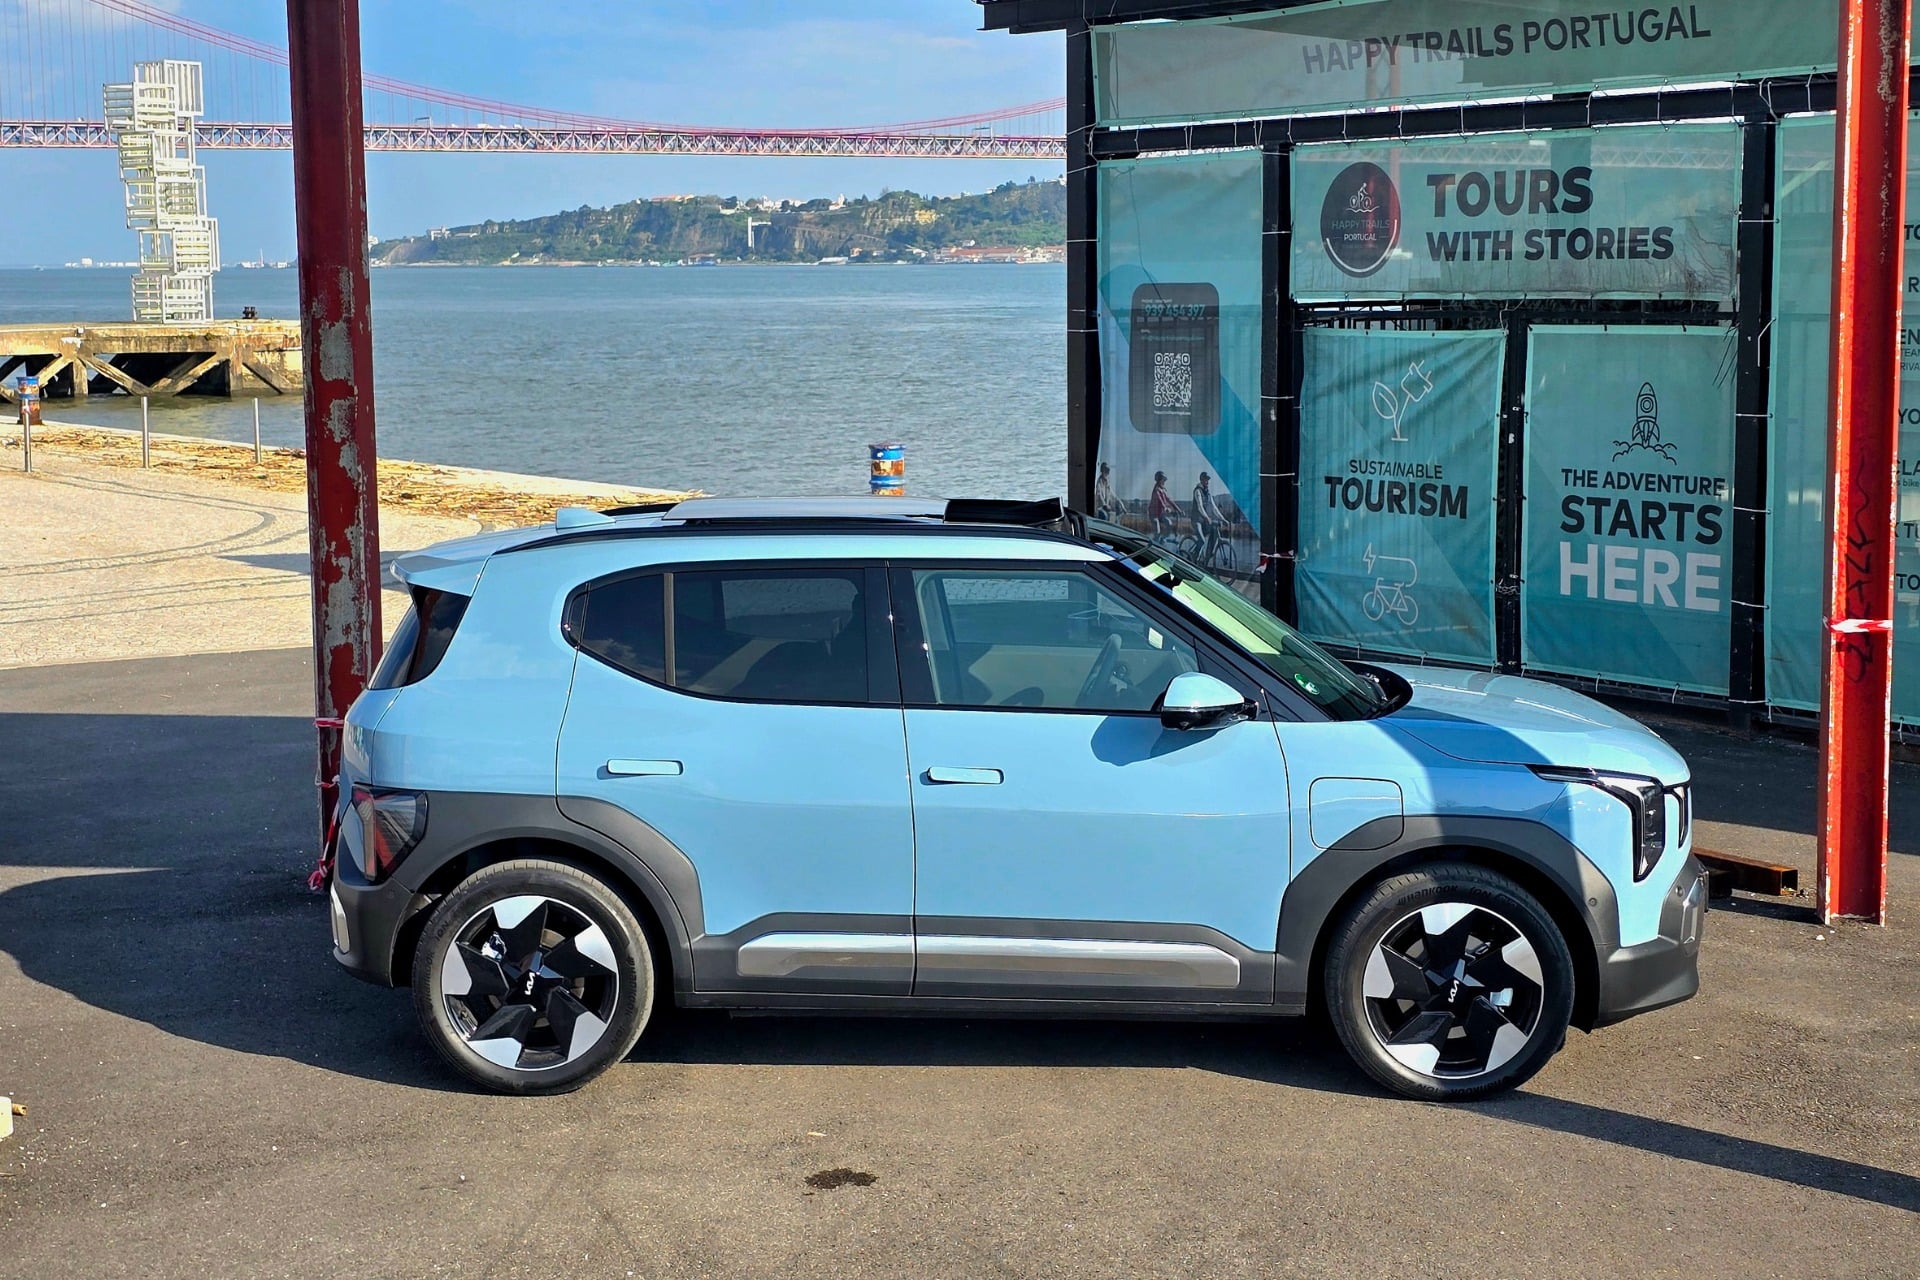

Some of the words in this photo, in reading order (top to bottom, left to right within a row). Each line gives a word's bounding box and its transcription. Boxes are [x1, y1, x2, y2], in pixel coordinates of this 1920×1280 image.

[1302, 35, 1400, 74] HAPPY
[1406, 24, 1513, 64] TRAILS
[1523, 5, 1711, 54] PORTUGAL
[1427, 166, 1594, 217] TOURS
[1331, 219, 1361, 229] HAPPY
[1361, 219, 1390, 229] TRAILS
[1343, 232, 1377, 241] PORTUGAL
[1426, 230, 1513, 261] WITH
[1524, 226, 1674, 260] STORIES
[1145, 304, 1163, 317] 939
[1187, 304, 1206, 317] 397
[1350, 459, 1443, 479] SUSTAINABLE
[1561, 468, 1598, 488] THE
[1602, 471, 1726, 497] ADVENTURE
[1324, 476, 1468, 519] TOURISM
[1560, 495, 1723, 545] STARTS
[1560, 541, 1721, 611] HERE
